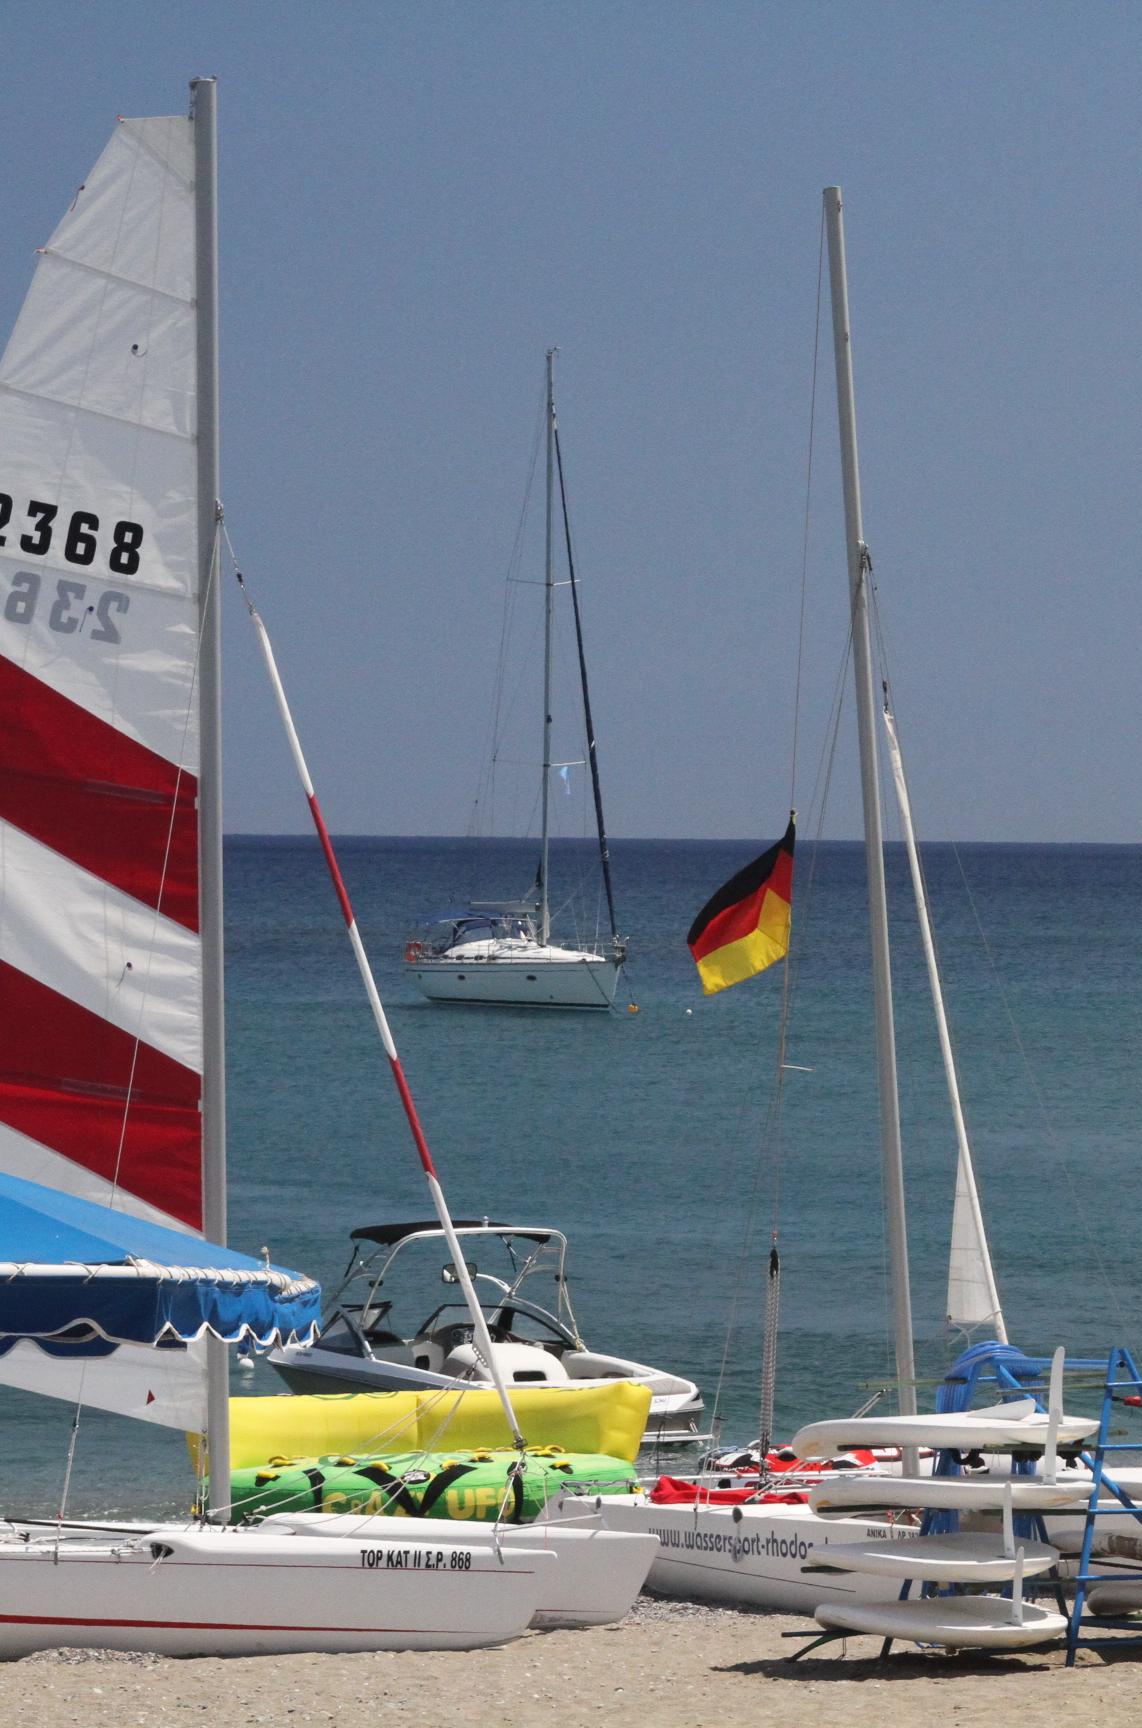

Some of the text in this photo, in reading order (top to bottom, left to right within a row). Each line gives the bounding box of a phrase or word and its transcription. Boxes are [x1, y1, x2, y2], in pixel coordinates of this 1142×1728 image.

[447, 1487, 515, 1520] UFO
[866, 1527, 888, 1539] ANIKA
[360, 1549, 383, 1568] TOP
[386, 1550, 410, 1568] KAT
[413, 1550, 422, 1568] II
[450, 1551, 472, 1570] 868
